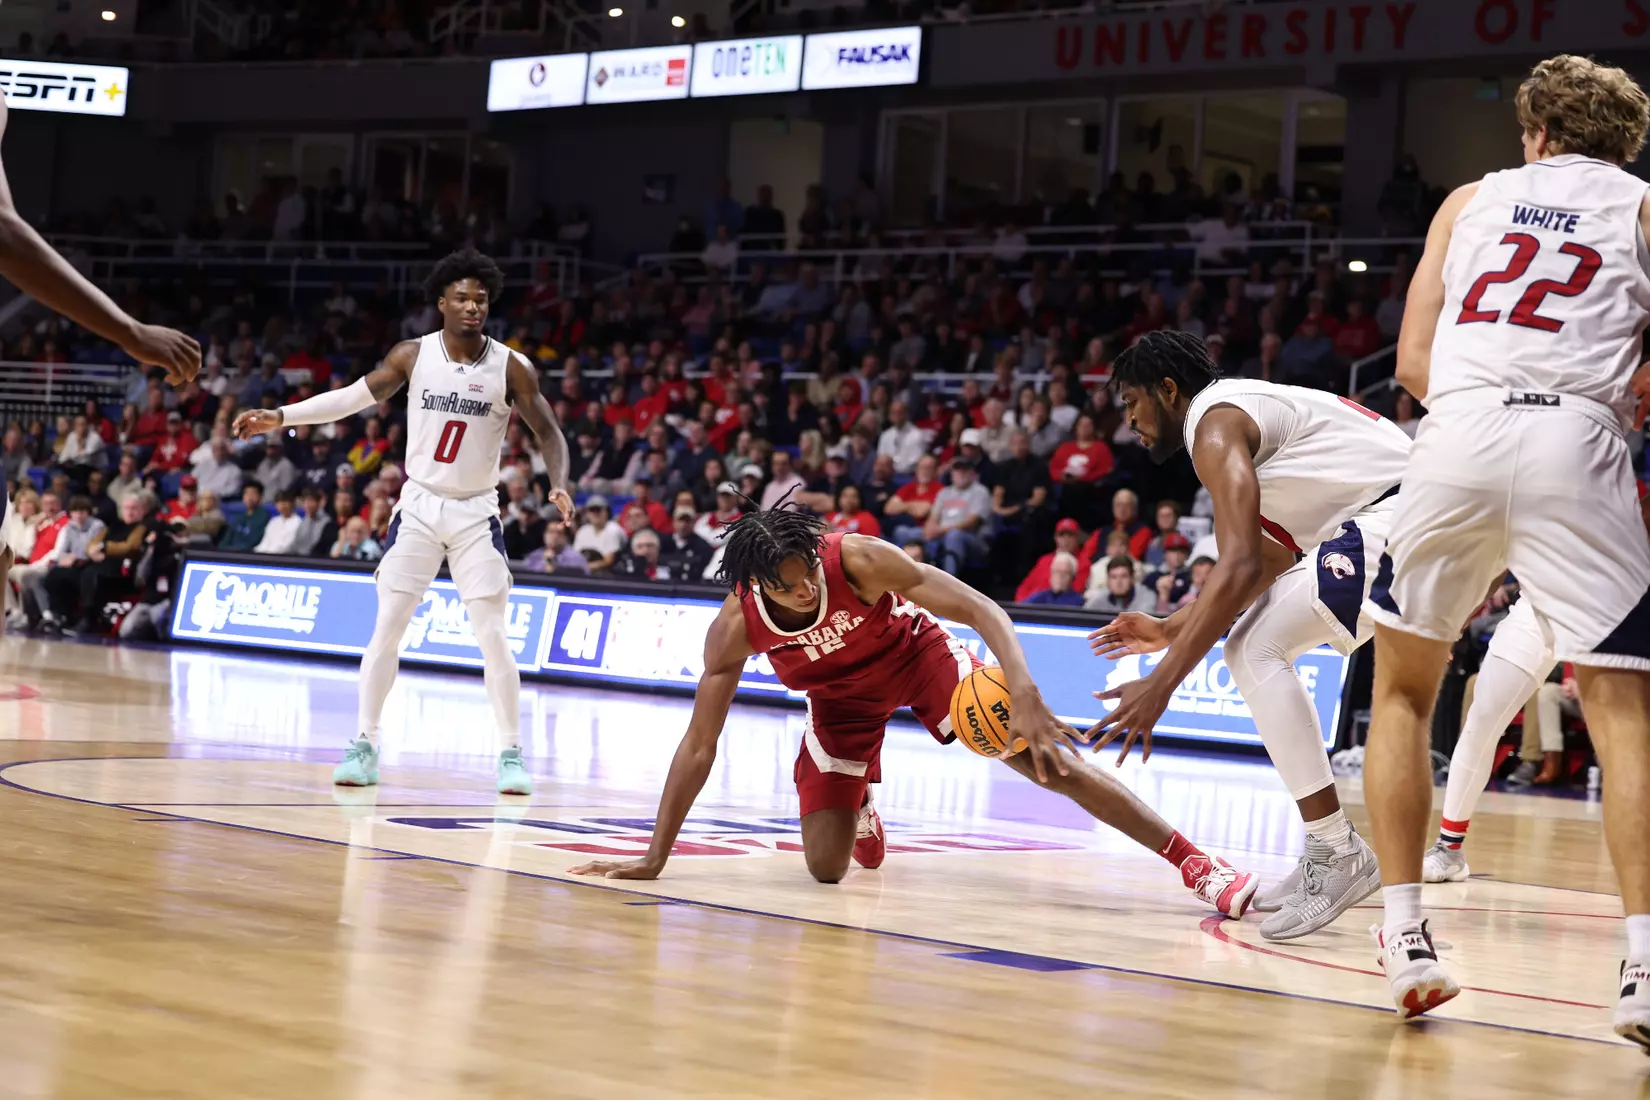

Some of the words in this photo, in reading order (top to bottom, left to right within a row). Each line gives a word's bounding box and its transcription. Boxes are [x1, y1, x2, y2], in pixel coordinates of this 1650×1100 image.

[1055, 3, 1415, 69] UNIVERSITY
[1475, 0, 1555, 44] OF
[1512, 205, 1580, 234] WHITE
[1456, 232, 1603, 333] 22
[433, 420, 468, 464] 0
[233, 581, 322, 619] MOBILE
[433, 597, 533, 637] MOLE
[770, 616, 866, 650] ABAMA
[1178, 658, 1319, 701] MOE
[965, 704, 1002, 757] Wilson
[1390, 937, 1423, 955] DAME
